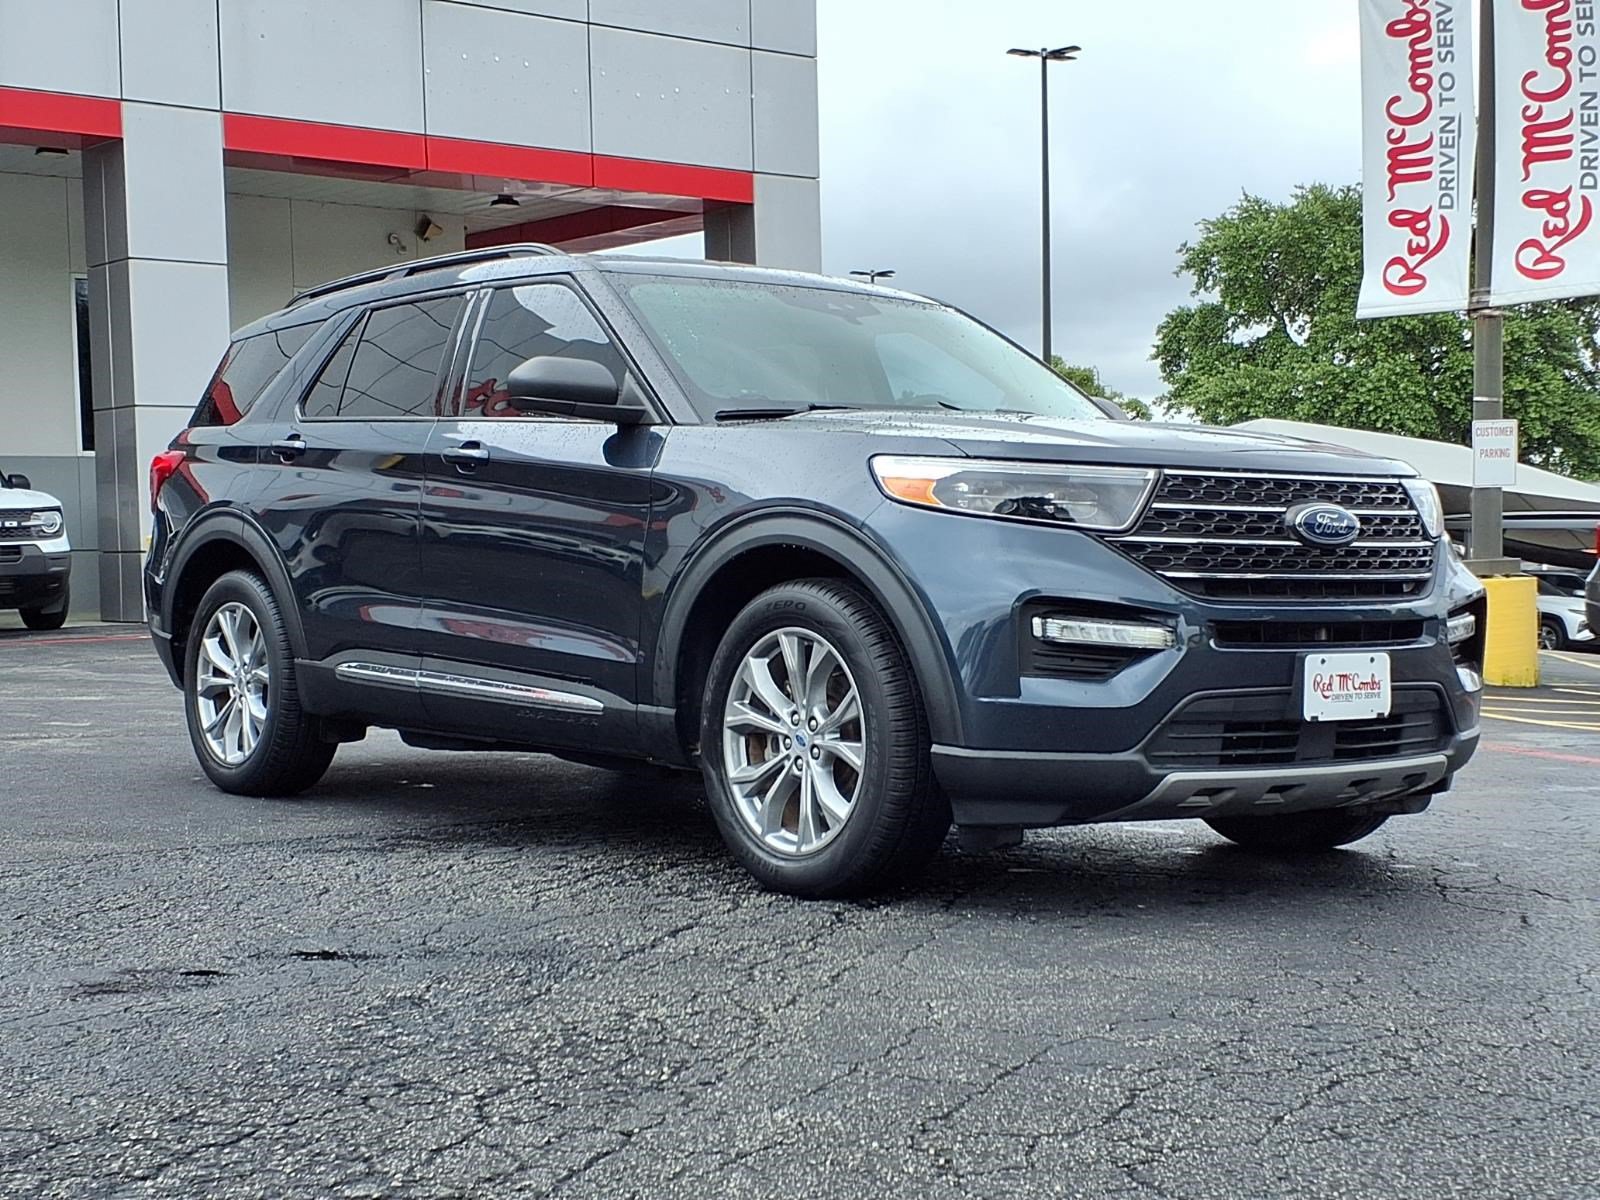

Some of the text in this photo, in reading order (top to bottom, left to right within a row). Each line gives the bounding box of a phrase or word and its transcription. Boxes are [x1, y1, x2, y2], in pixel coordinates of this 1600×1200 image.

[1578, 45, 1598, 83] TO
[1439, 72, 1456, 108] TO
[1579, 92, 1600, 190] DRIVEN
[1438, 115, 1455, 210] DRIVEN
[1383, 205, 1450, 296] Red
[1515, 185, 1592, 280] Red
[1476, 427, 1513, 437] CUSTOMER
[1480, 448, 1510, 458] PARKING
[1314, 512, 1348, 533] Ford
[1313, 672, 1381, 699] Red McCombs
[1331, 693, 1354, 701] DRIVEN
